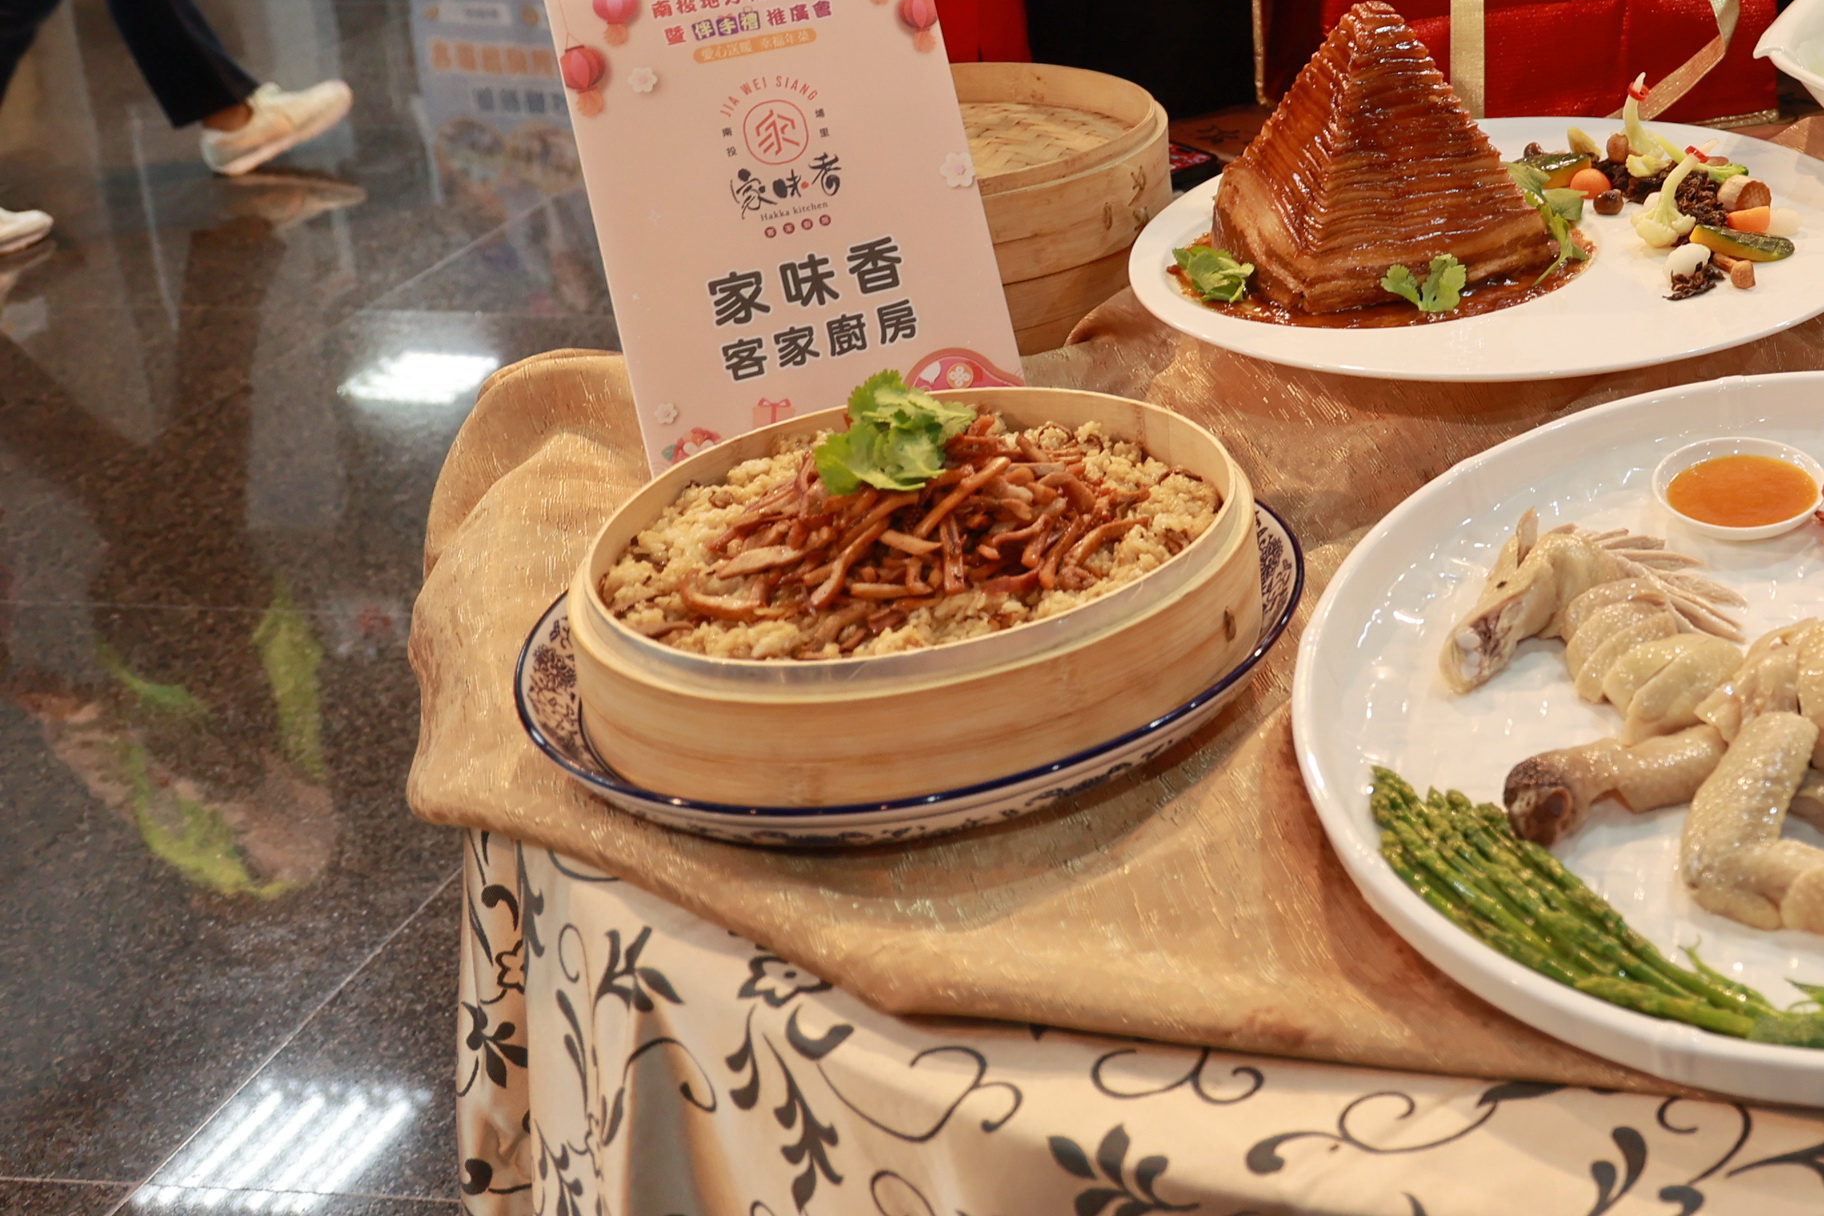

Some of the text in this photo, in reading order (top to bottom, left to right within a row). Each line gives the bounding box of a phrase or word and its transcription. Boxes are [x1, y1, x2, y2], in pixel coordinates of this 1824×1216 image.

[720, 75, 818, 118] JIA WEI SIANG
[730, 152, 842, 220] 家味香
[760, 201, 829, 222] Hakka kitchen
[707, 236, 902, 327] 家味香
[721, 299, 917, 382] 客家廚房
